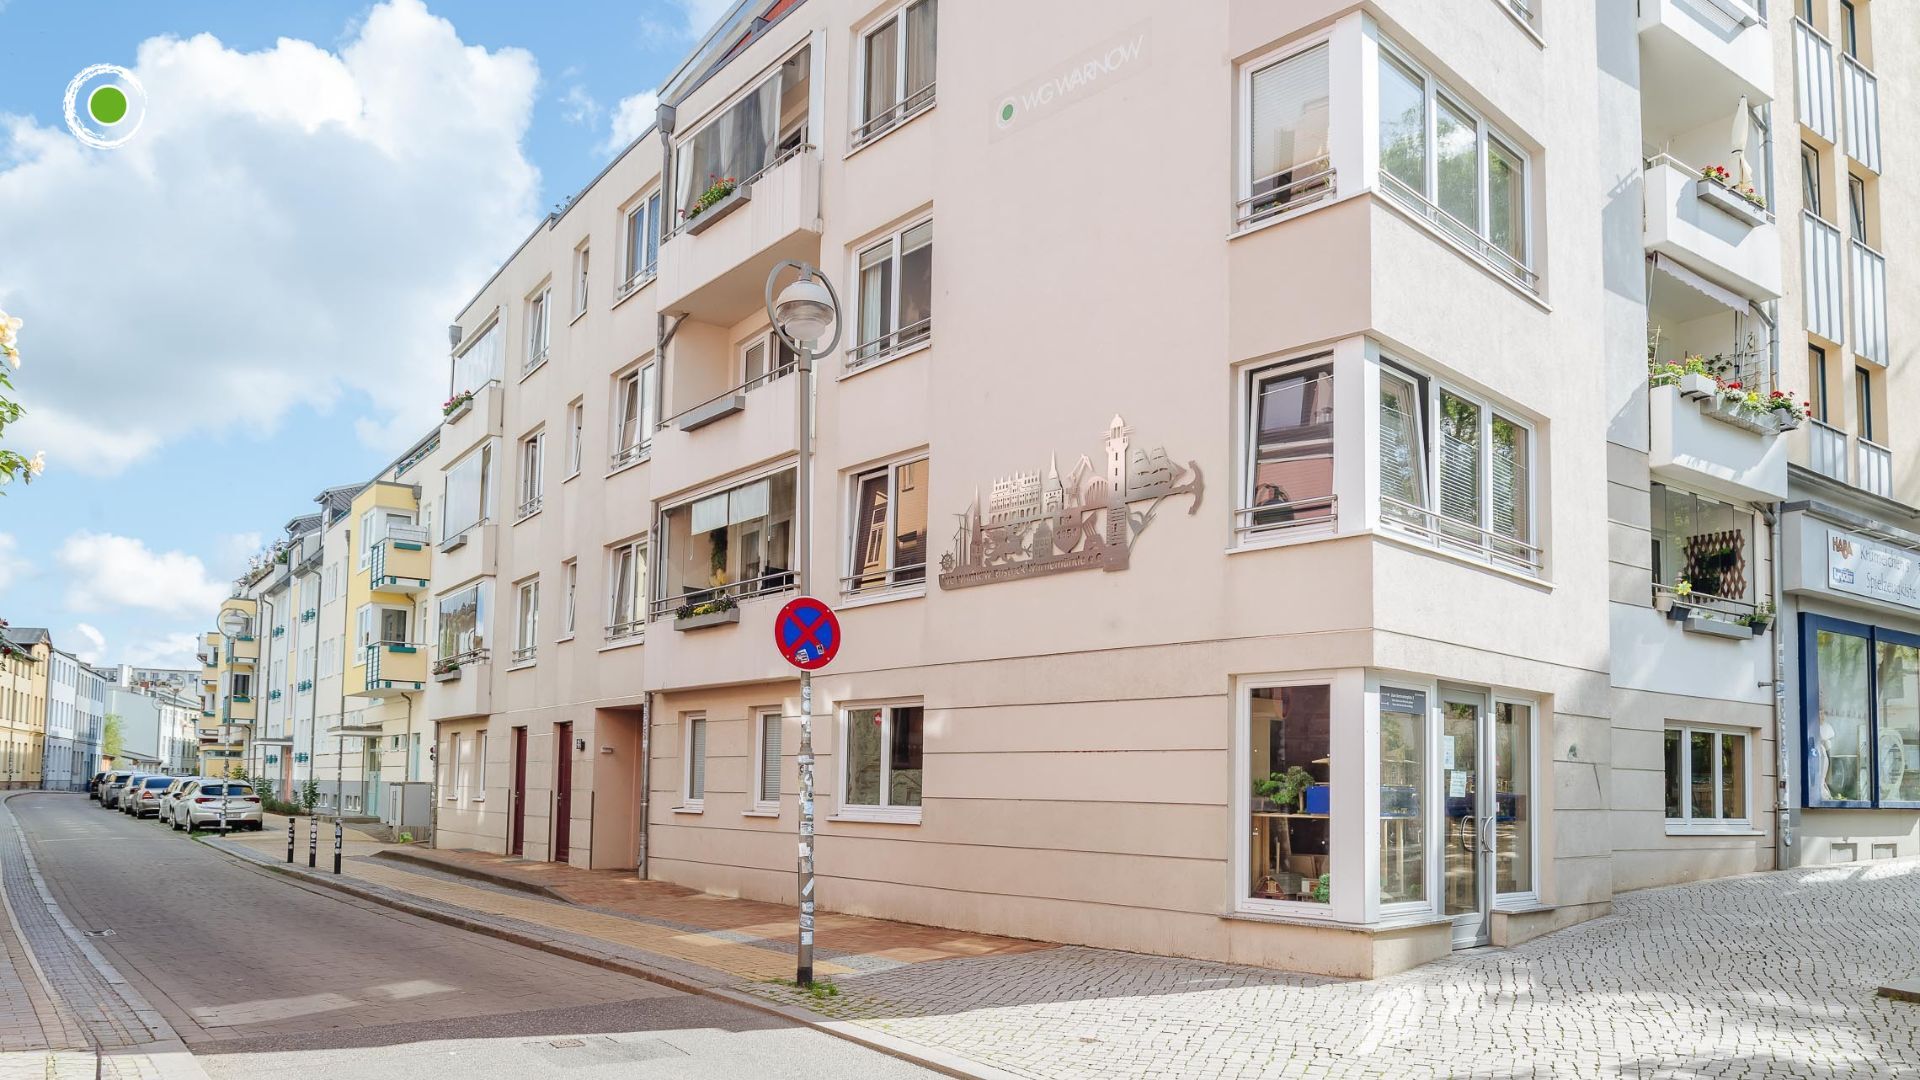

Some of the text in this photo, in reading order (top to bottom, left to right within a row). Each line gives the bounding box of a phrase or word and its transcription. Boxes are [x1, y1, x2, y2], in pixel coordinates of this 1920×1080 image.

[1021, 34, 1144, 112] WG WARNOW
[1832, 536, 1854, 560] HABA
[1866, 571, 1917, 600] Spielzeugkiste
